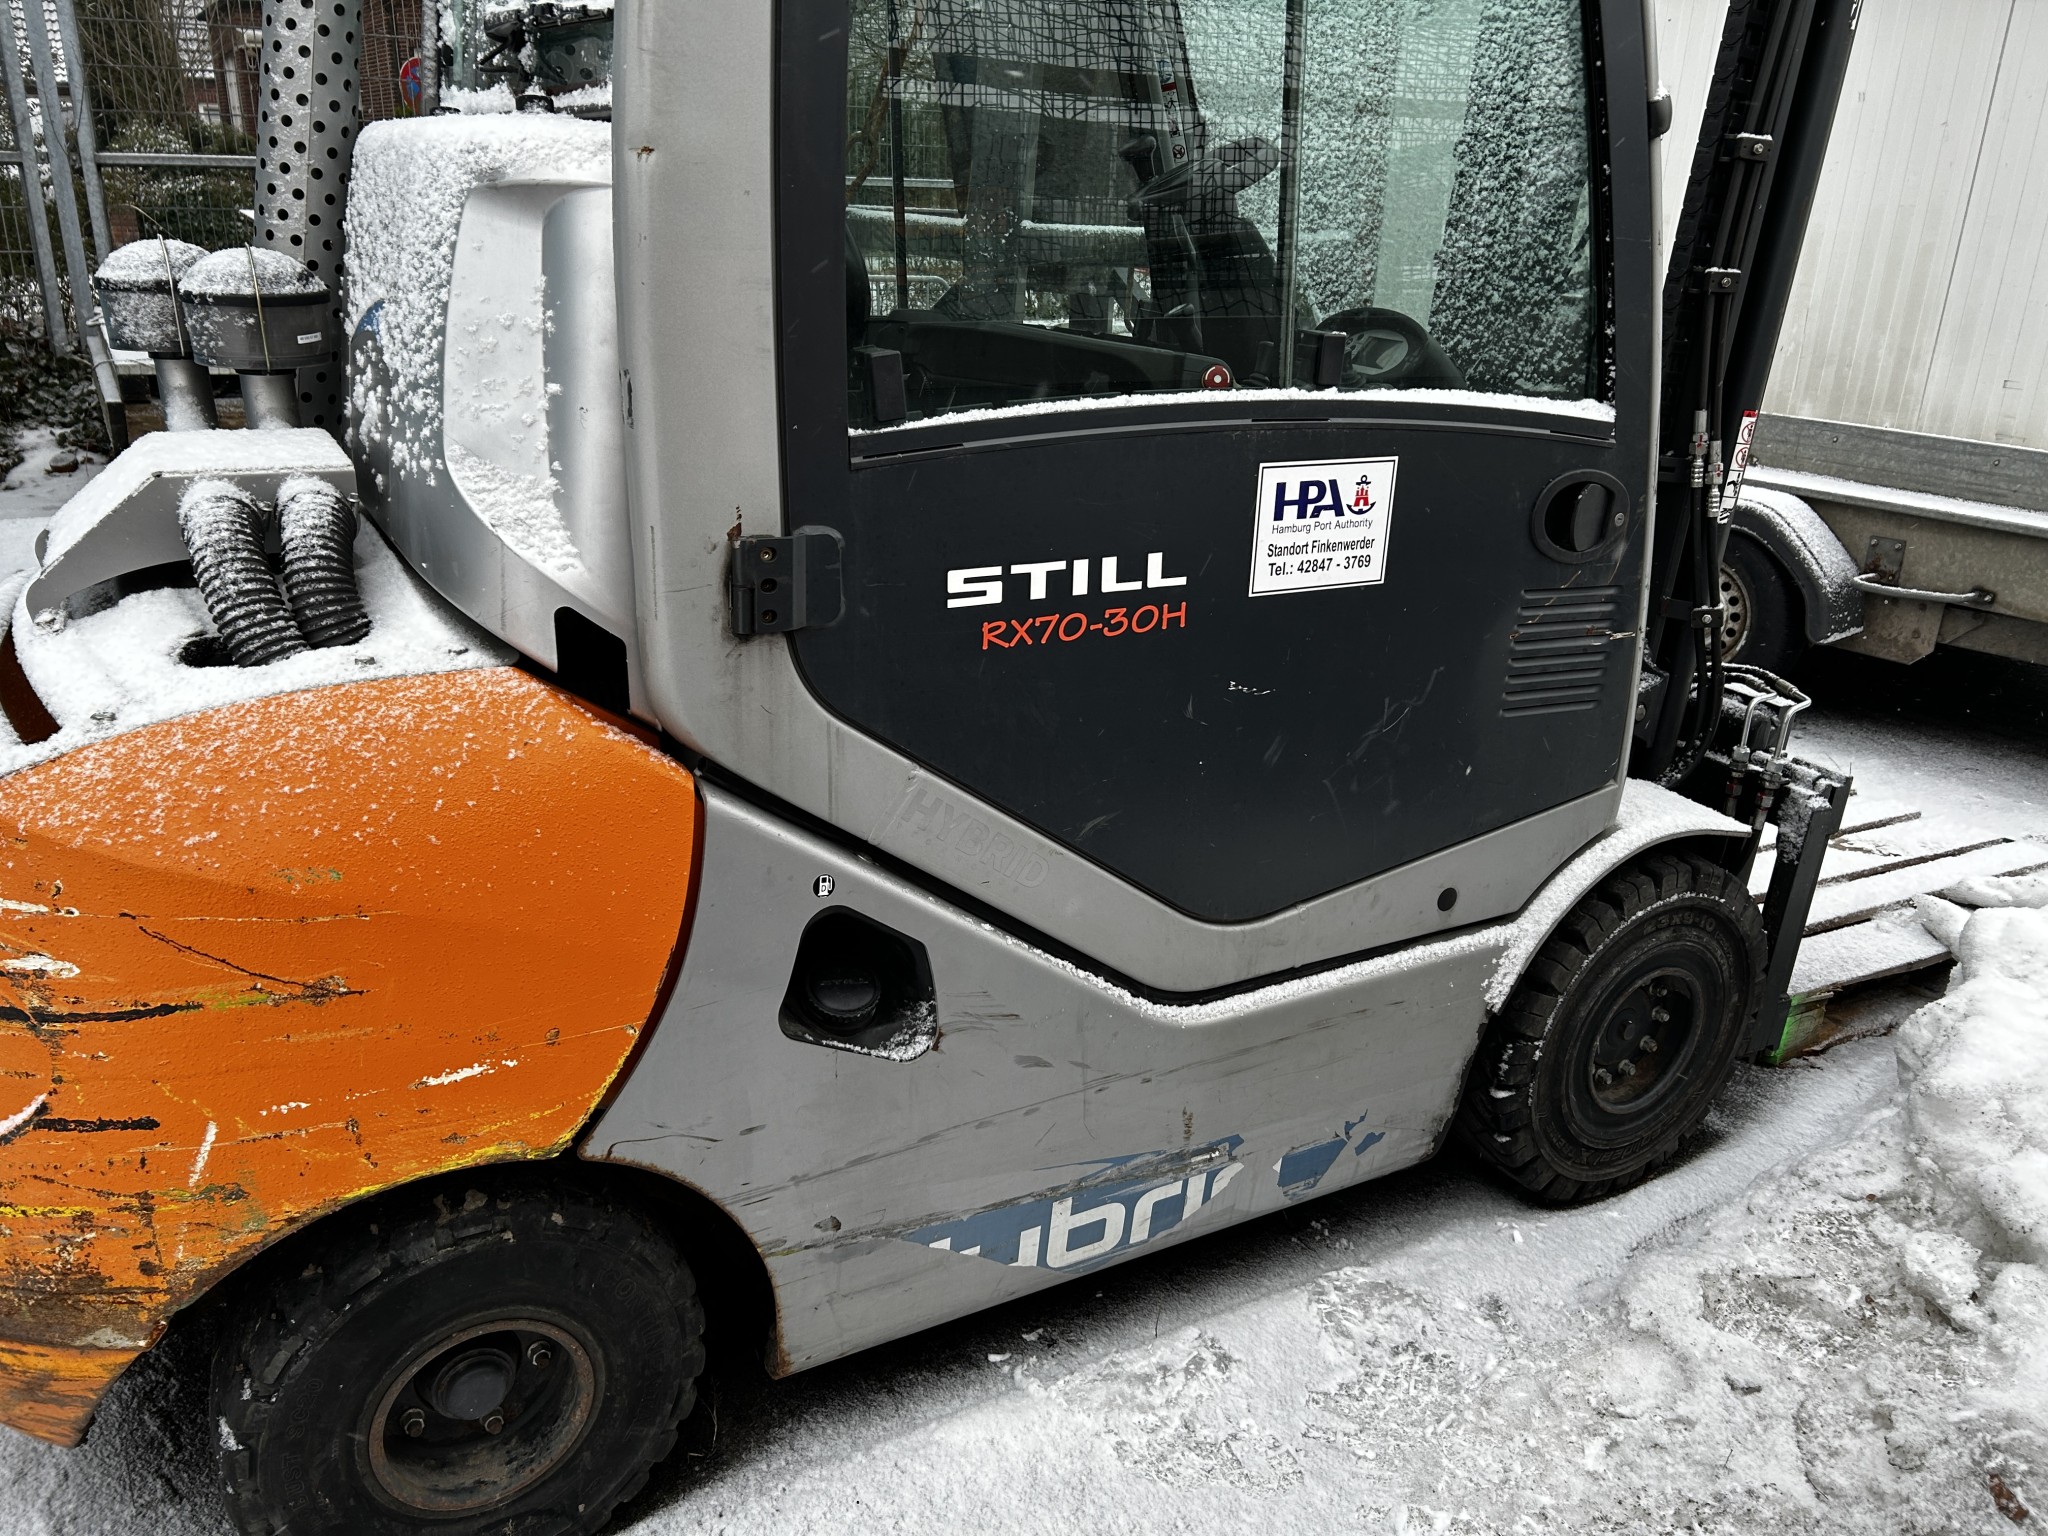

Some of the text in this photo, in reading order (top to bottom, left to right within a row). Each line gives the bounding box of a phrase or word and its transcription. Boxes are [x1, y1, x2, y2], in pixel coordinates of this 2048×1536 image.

[1273, 478, 1345, 521] HPA
[1267, 536, 1375, 558] Standort Finkenwerder
[1272, 518, 1373, 535] Hamburg Port Authority
[947, 551, 1187, 609] STILL
[1268, 561, 1293, 577] Tel.:
[1297, 558, 1333, 574] 42847
[1344, 554, 1371, 570] 3769
[981, 601, 1187, 650] RX70-30H
[900, 787, 1049, 888] HYBRID
